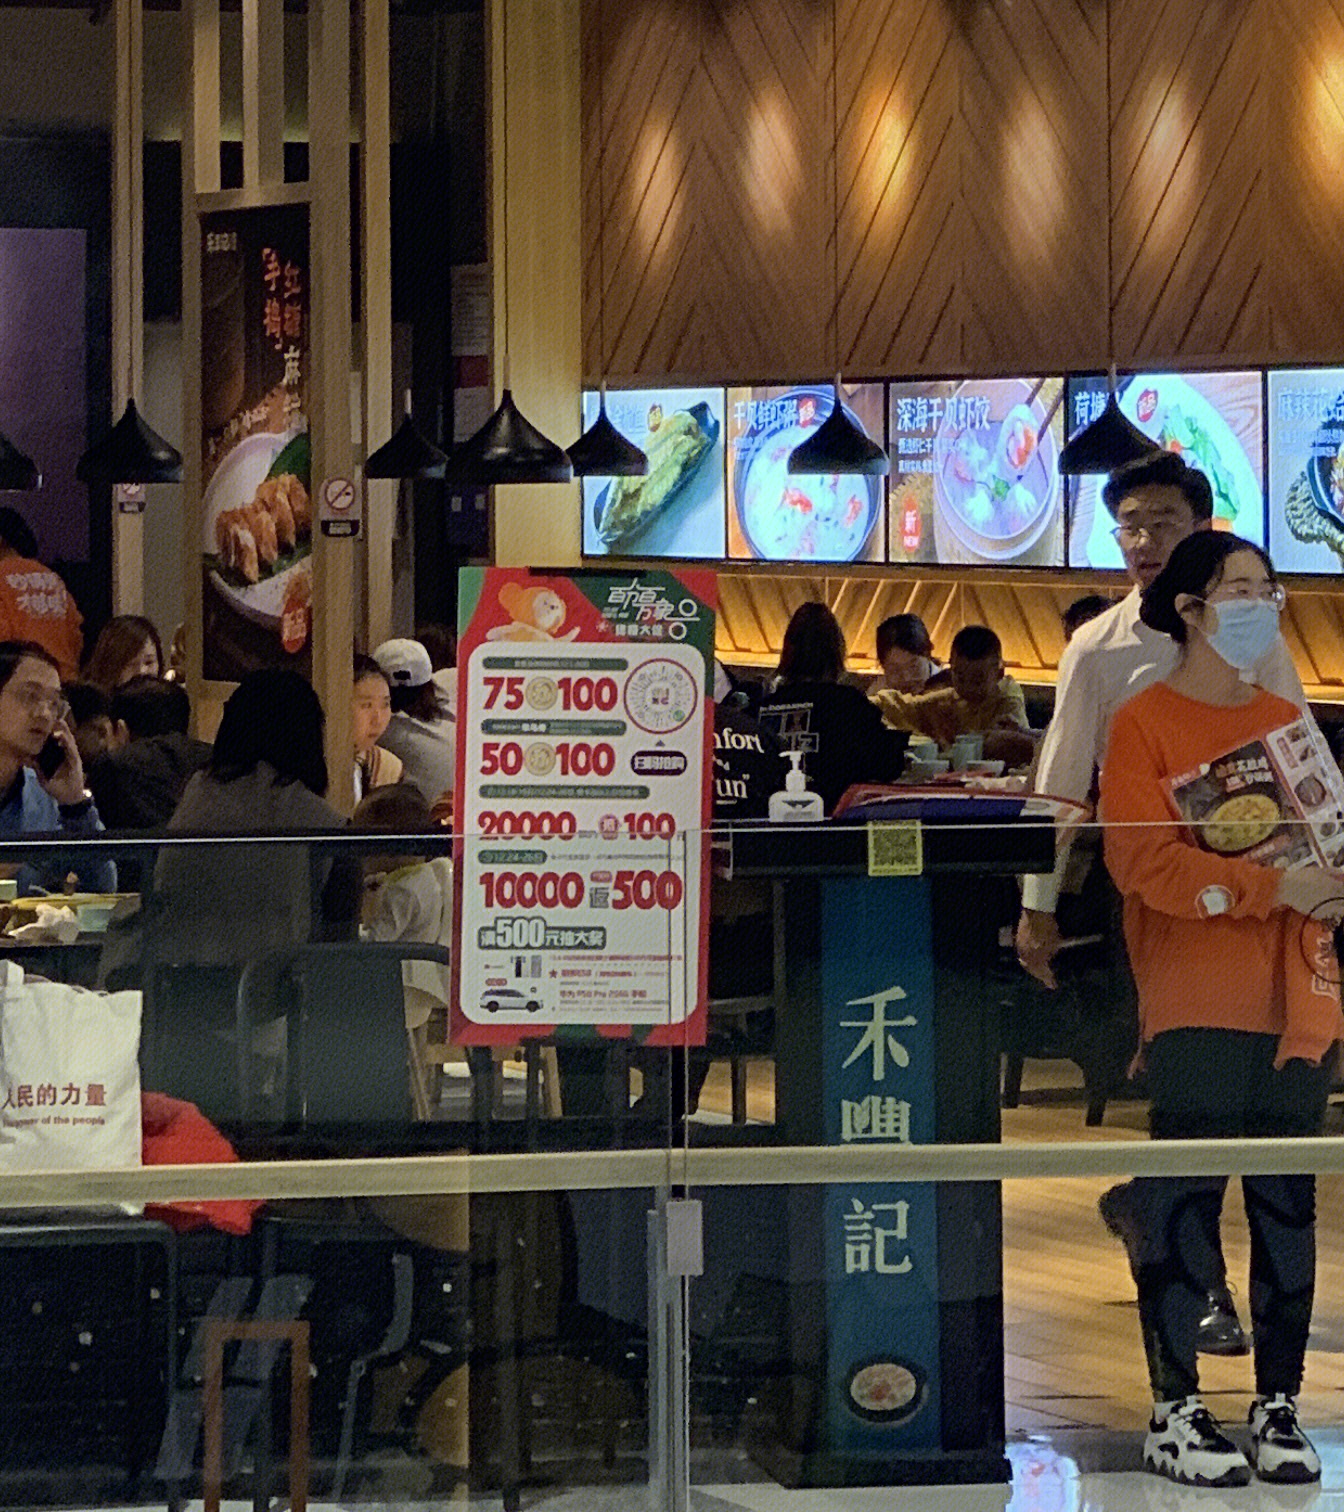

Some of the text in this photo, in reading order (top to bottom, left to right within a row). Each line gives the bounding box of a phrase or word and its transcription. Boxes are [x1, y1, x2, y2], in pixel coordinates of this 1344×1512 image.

[896, 396, 992, 433] 深海干贝虾饺
[482, 676, 525, 710] 75
[558, 676, 619, 711] 100
[480, 742, 523, 777] 50
[556, 742, 616, 777] 100
[478, 811, 576, 840] 20000
[624, 812, 676, 840] 100
[479, 871, 585, 909] 10000
[612, 870, 683, 910] 500
[2, 1082, 107, 1109] 人民的力量
[73, 1115, 106, 1127] people
